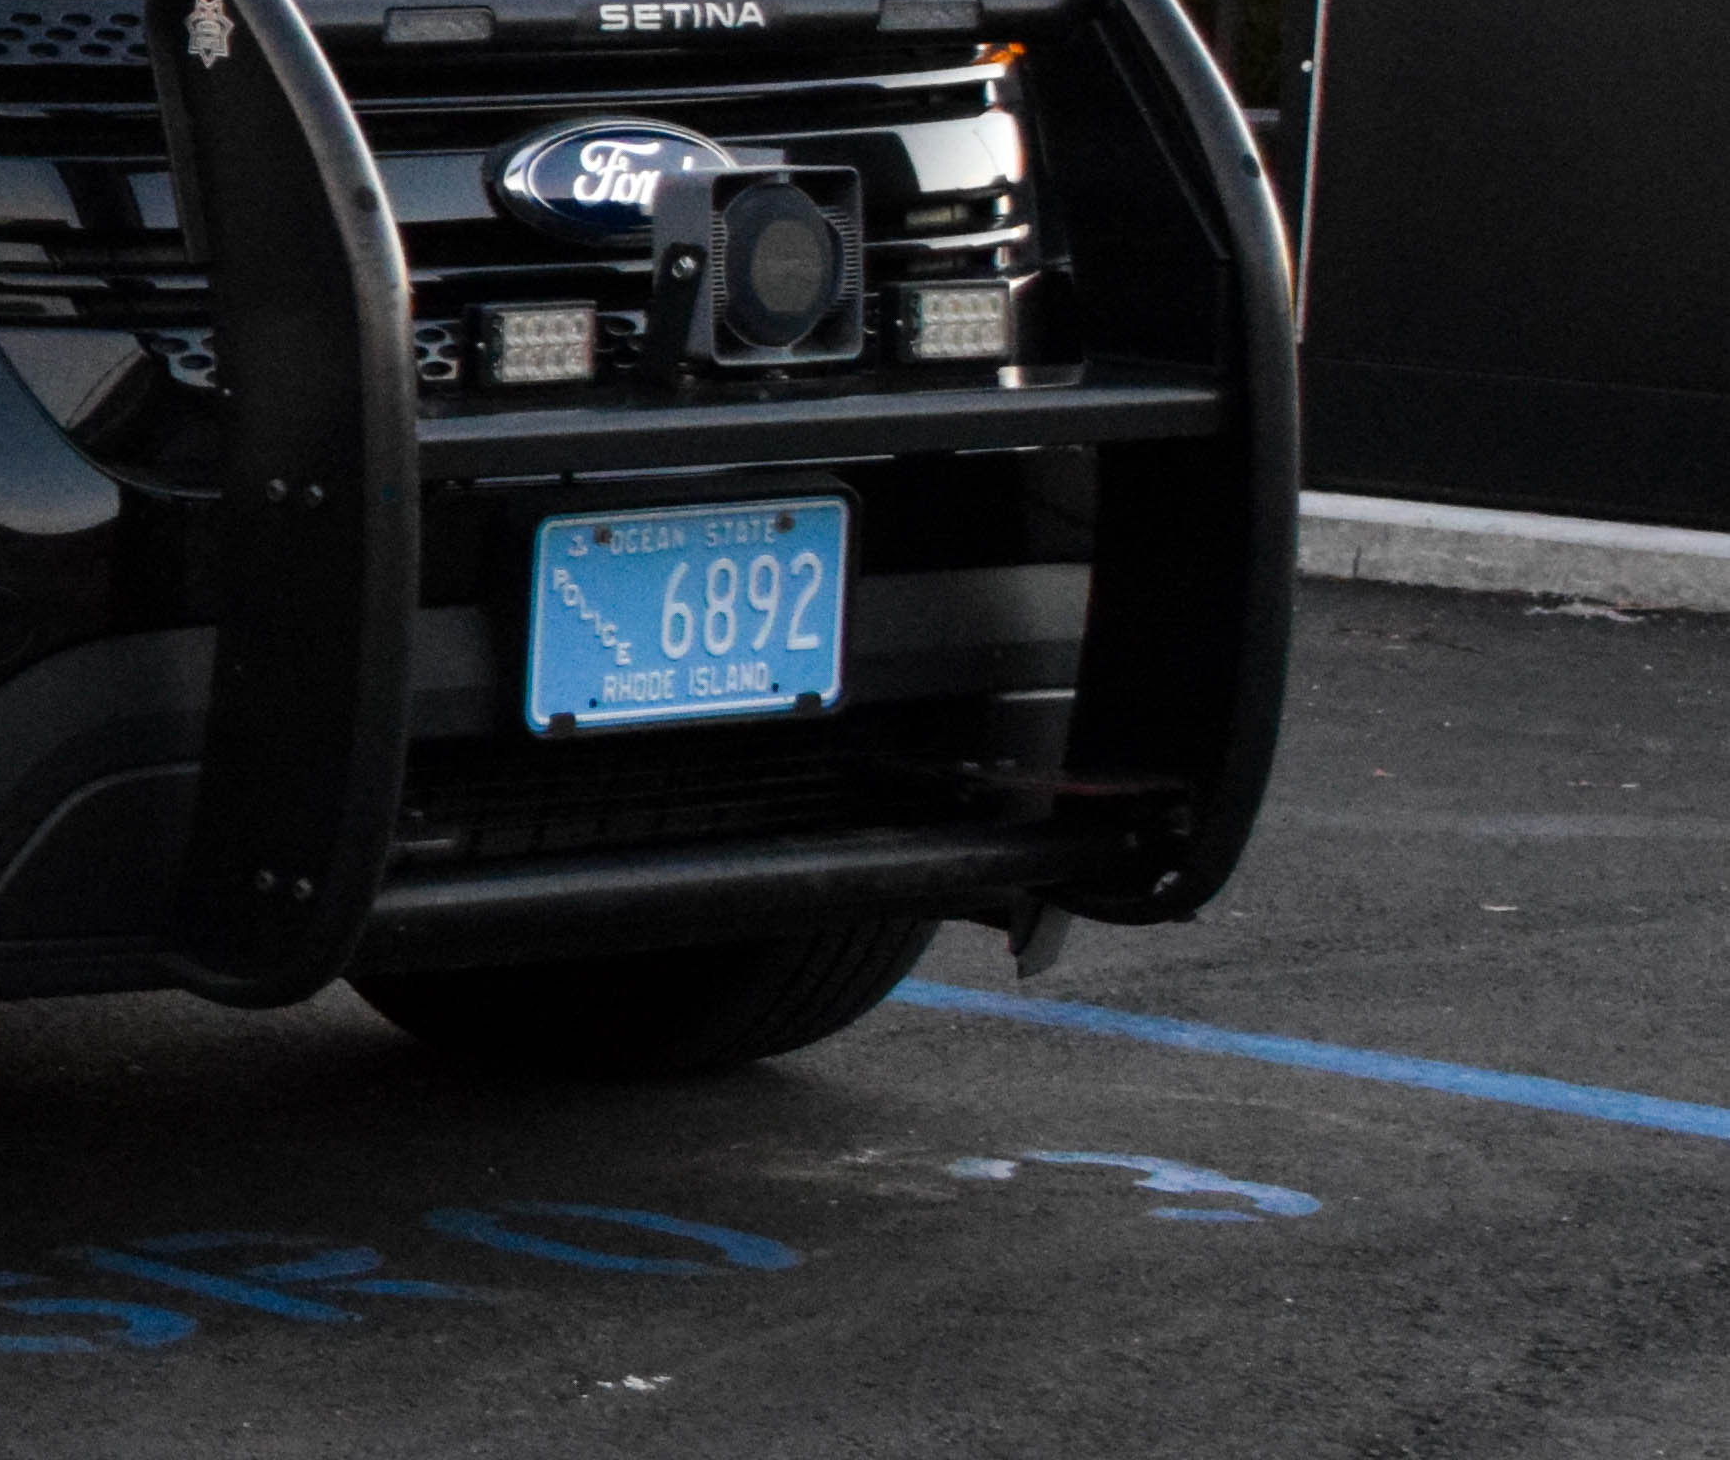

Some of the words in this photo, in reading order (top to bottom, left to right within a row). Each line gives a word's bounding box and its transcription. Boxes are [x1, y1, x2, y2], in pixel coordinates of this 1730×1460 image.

[599, 1, 767, 31] SETINA
[609, 525, 685, 556] OCEAN
[705, 517, 779, 547] STATE
[553, 568, 632, 667] POLICE
[659, 551, 822, 660] 6892
[602, 670, 675, 703] RHODE
[689, 661, 770, 698] ISLAND
